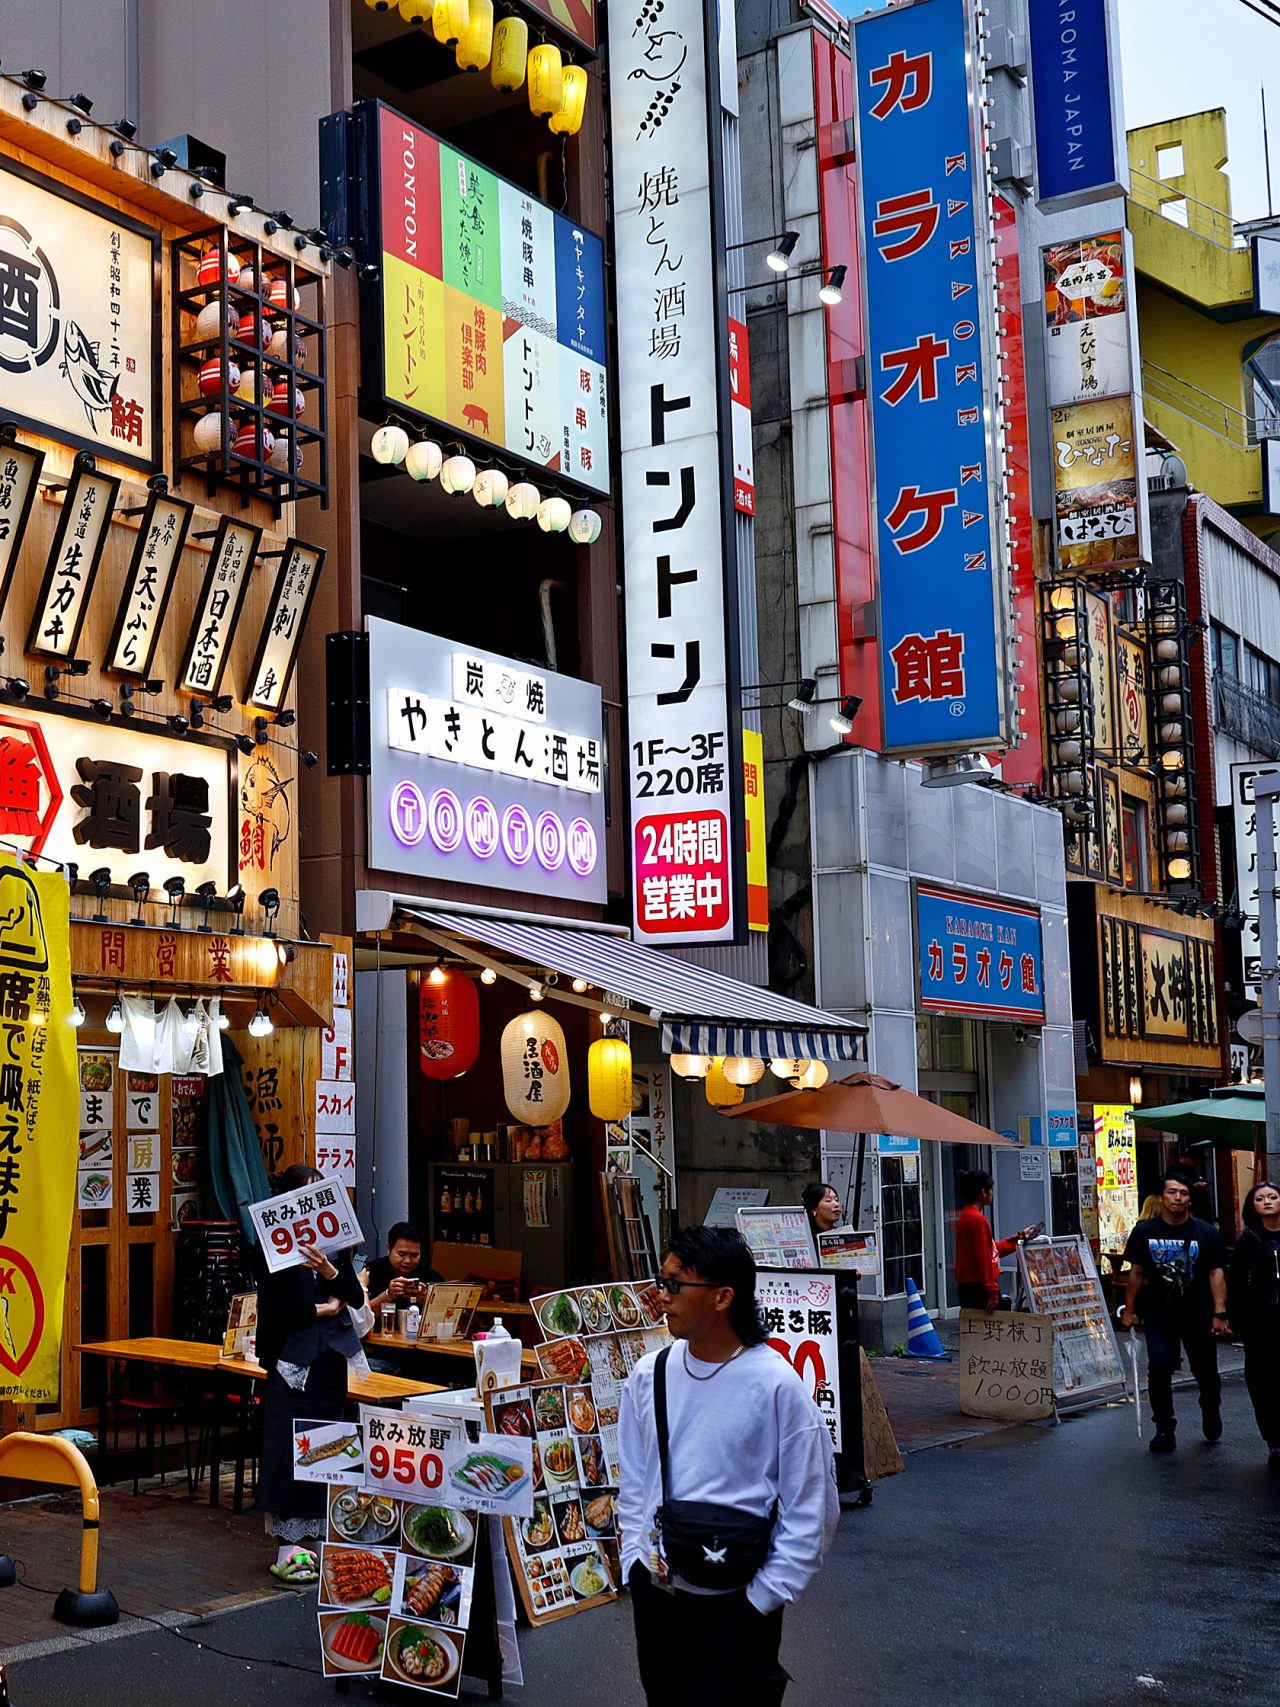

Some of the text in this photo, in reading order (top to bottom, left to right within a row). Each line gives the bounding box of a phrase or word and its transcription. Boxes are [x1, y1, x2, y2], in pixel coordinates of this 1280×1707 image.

[1063, 92, 1086, 173] JAPAN
[402, 130, 417, 260] TONTON
[521, 215, 535, 288] 焼豚串
[637, 165, 687, 361] 焼とん酒場
[109, 229, 122, 370] 創業昭和四十二年
[403, 284, 419, 401] トントン
[461, 322, 474, 392] 倶楽部
[473, 306, 487, 376] 焼豚肉
[943, 152, 988, 572] KARAOKE KAN
[523, 338, 535, 452] トントン
[867, 47, 968, 707] カラオケ館
[110, 392, 145, 447] 鮪
[1055, 432, 1132, 469] ひなた
[645, 383, 702, 706] トントン
[1063, 514, 1133, 541] はなび
[121, 565, 158, 667] 天ぷら
[188, 588, 231, 687] 日本酒
[255, 603, 298, 700] 刺身
[400, 696, 600, 789] やきとん酒場
[70, 755, 213, 864] 酒場
[635, 763, 725, 800] 220席
[395, 788, 593, 868] TONTON
[641, 818, 722, 867] 24時間
[642, 871, 723, 921] 営業中
[945, 915, 1018, 945] KARAOKE KAN
[927, 939, 1037, 995] カラオケ館
[522, 1037, 544, 1103] 居酒屋
[316, 1094, 354, 1117] スカイ
[316, 1147, 356, 1170] テラス
[261, 1187, 337, 1229] 飲み放題
[271, 1210, 340, 1255] 950
[961, 1319, 1045, 1344] 上野横丁
[967, 1355, 1048, 1380] 飲み放題
[974, 1378, 1053, 1406] 1000円
[369, 1417, 452, 1450] 飲み放題
[308, 1470, 345, 1482] サンマ塩焼き
[370, 1444, 444, 1490] 950
[565, 1543, 594, 1557] チャーハン
